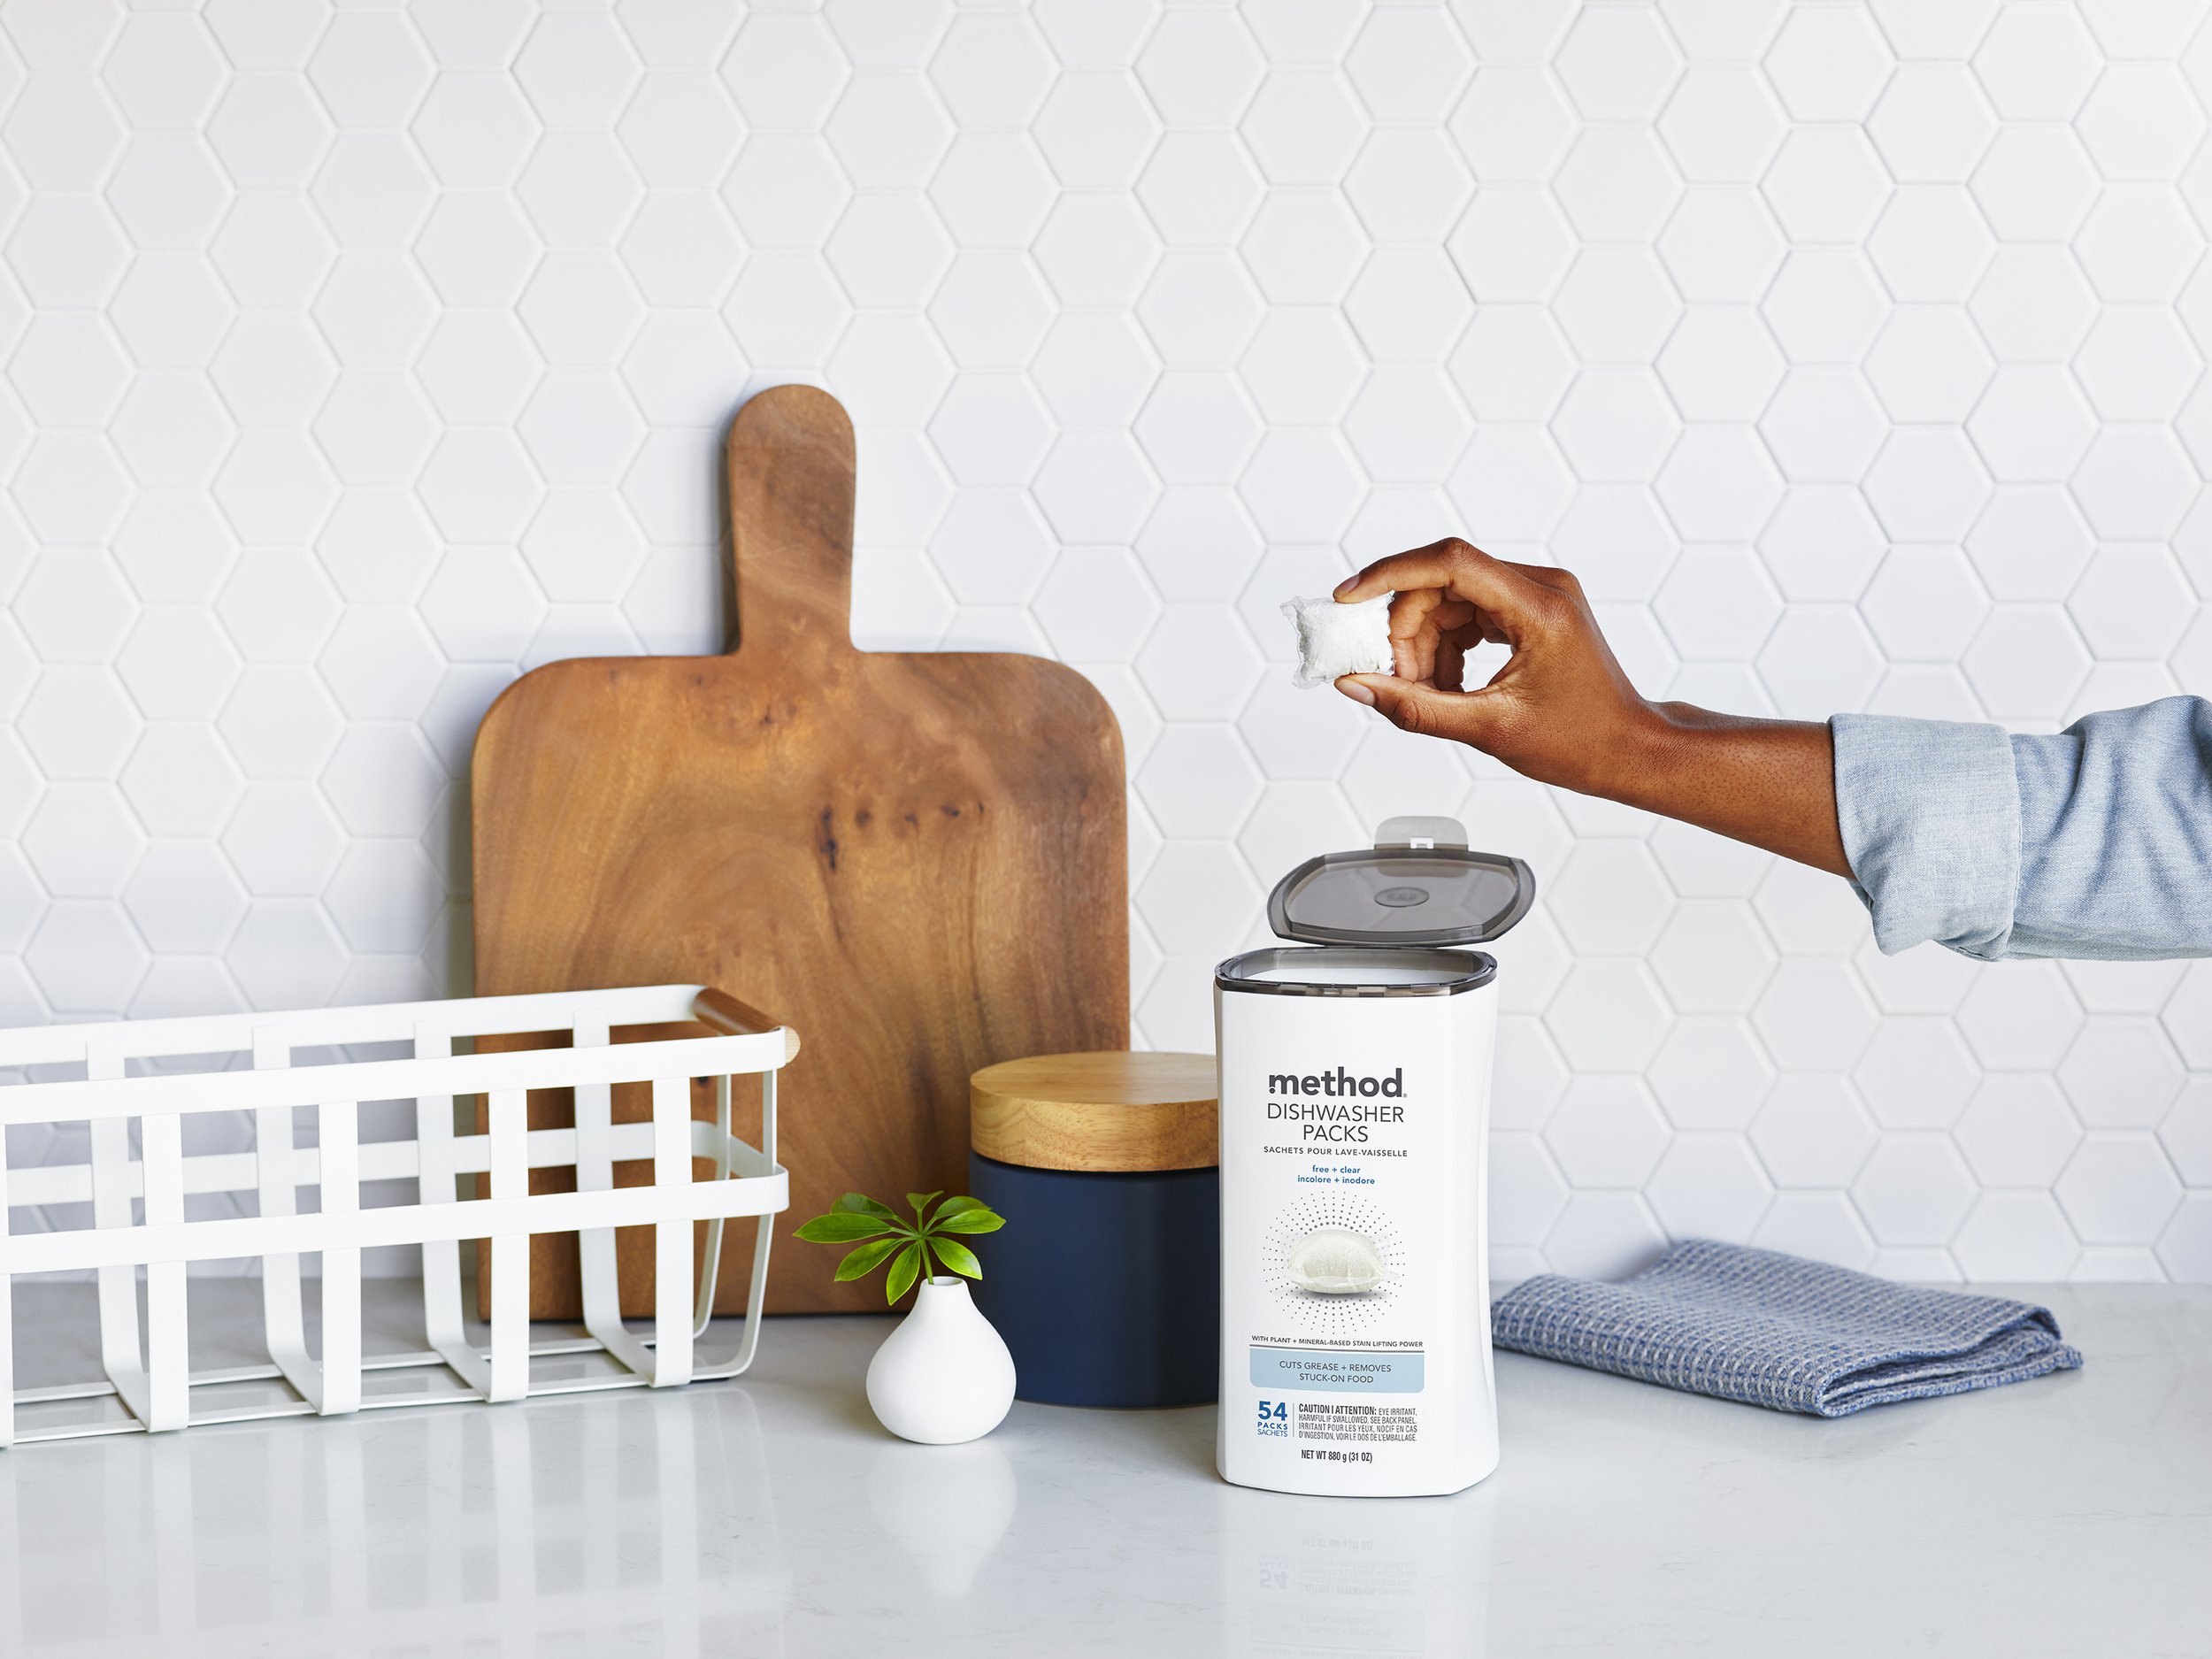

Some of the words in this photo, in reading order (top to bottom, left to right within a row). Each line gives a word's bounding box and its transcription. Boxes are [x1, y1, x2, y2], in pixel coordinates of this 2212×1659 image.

[1268, 1103, 1403, 1123] DISHWASHER
[1303, 1125, 1368, 1142] PACKS
[1279, 1360, 1302, 1369] CUTS
[1303, 1362, 1339, 1371] GREASE
[1349, 1363, 1391, 1372] REMOVES
[1300, 1373, 1344, 1382] STUCK-ON
[1258, 1401, 1287, 1421] 54
[1299, 1403, 1330, 1414] CAUTION
[1335, 1406, 1377, 1415] ATTENTION:
[1299, 1422, 1325, 1431] IRRITANT
[1302, 1449, 1314, 1459] NET
[1316, 1450, 1326, 1460] WT
[1328, 1451, 1340, 1461] 880
[1342, 1454, 1347, 1463] g
[1348, 1452, 1358, 1463] (31
[1361, 1452, 1372, 1463] OZ)
